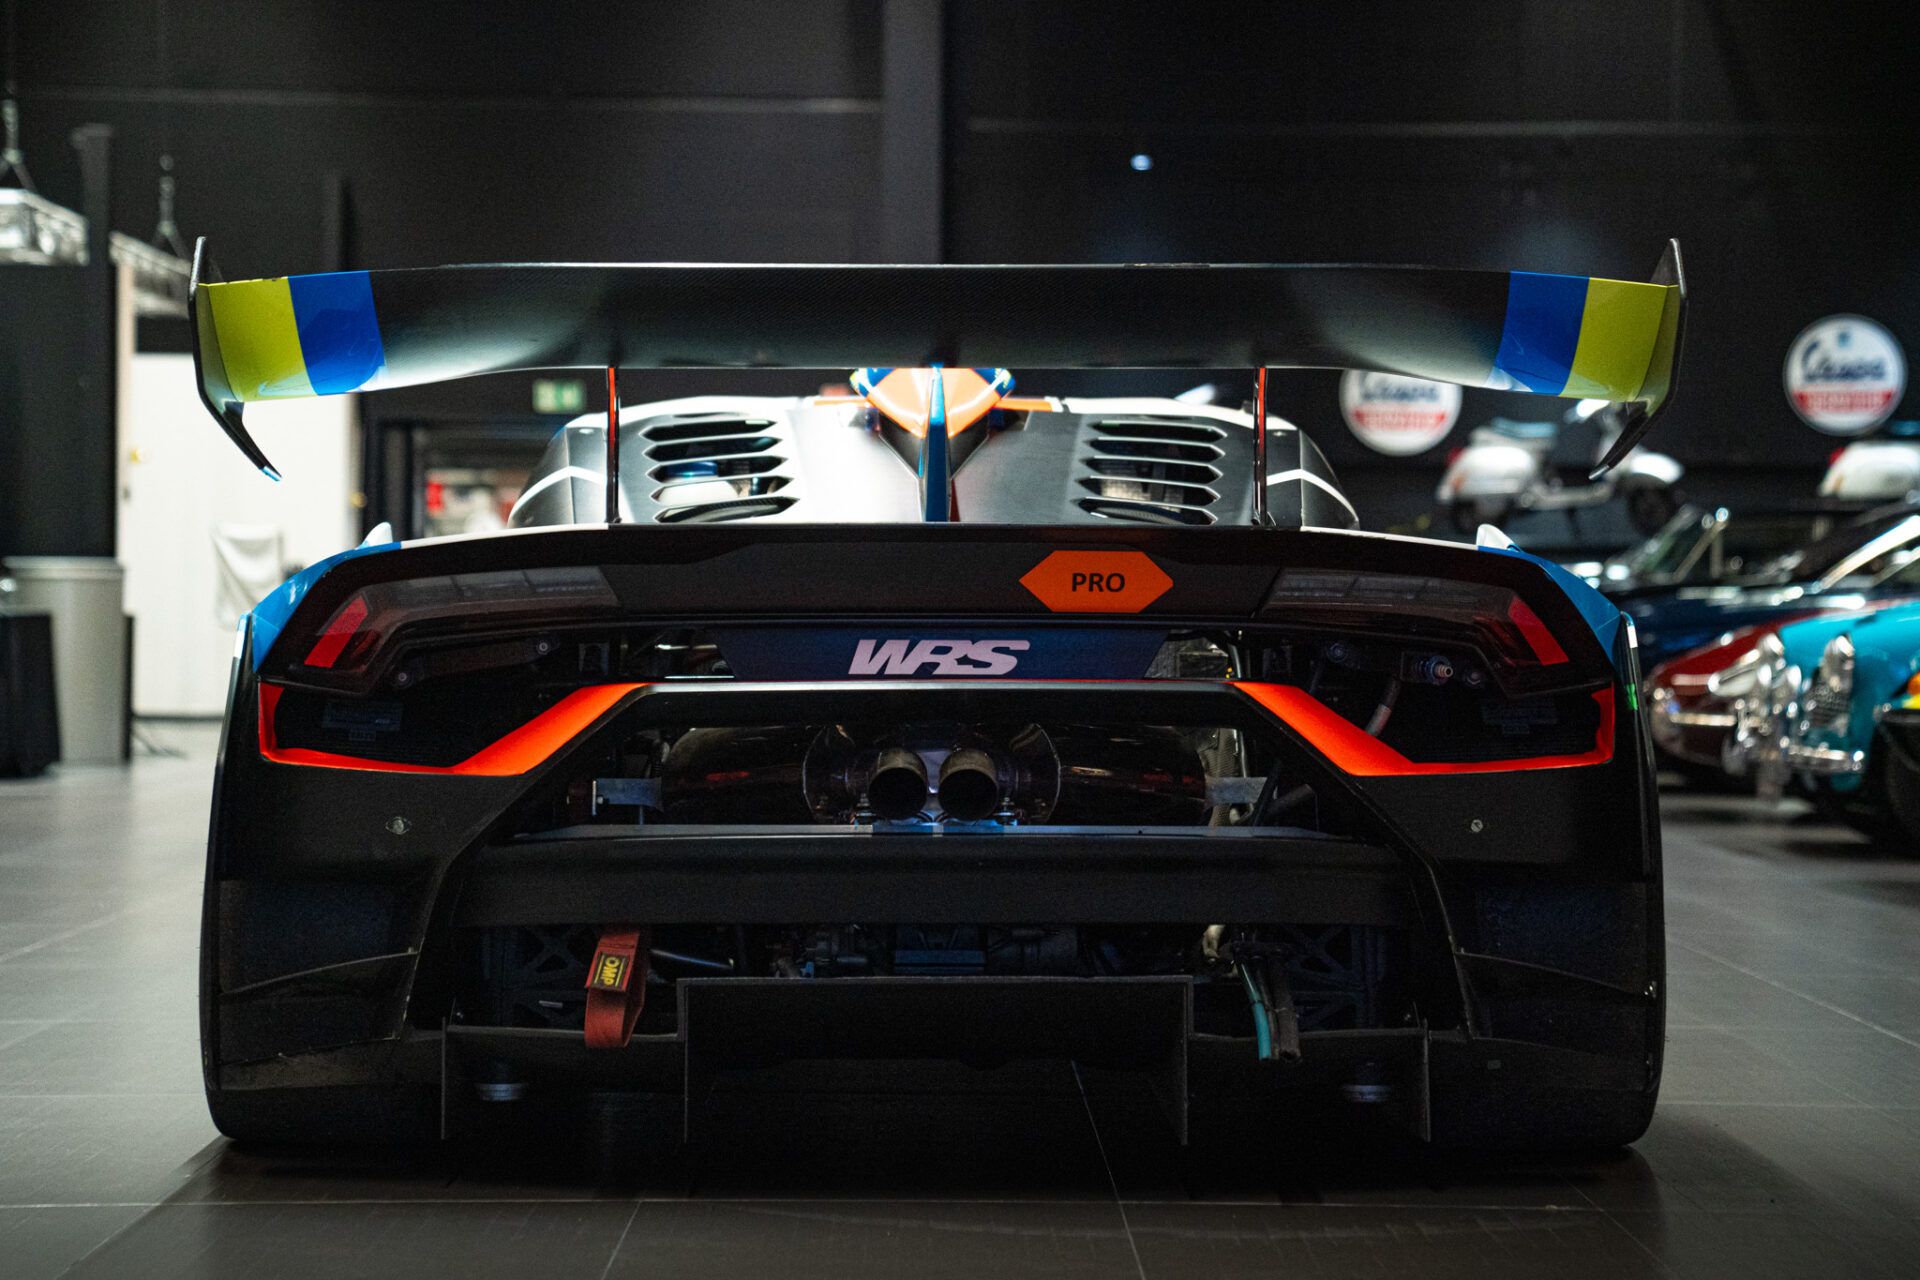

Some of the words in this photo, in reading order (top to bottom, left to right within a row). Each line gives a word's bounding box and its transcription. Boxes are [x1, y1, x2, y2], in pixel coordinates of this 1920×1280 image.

[1071, 572, 1126, 593] PRO
[848, 639, 1031, 675] WRS
[601, 957, 619, 986] OMP
